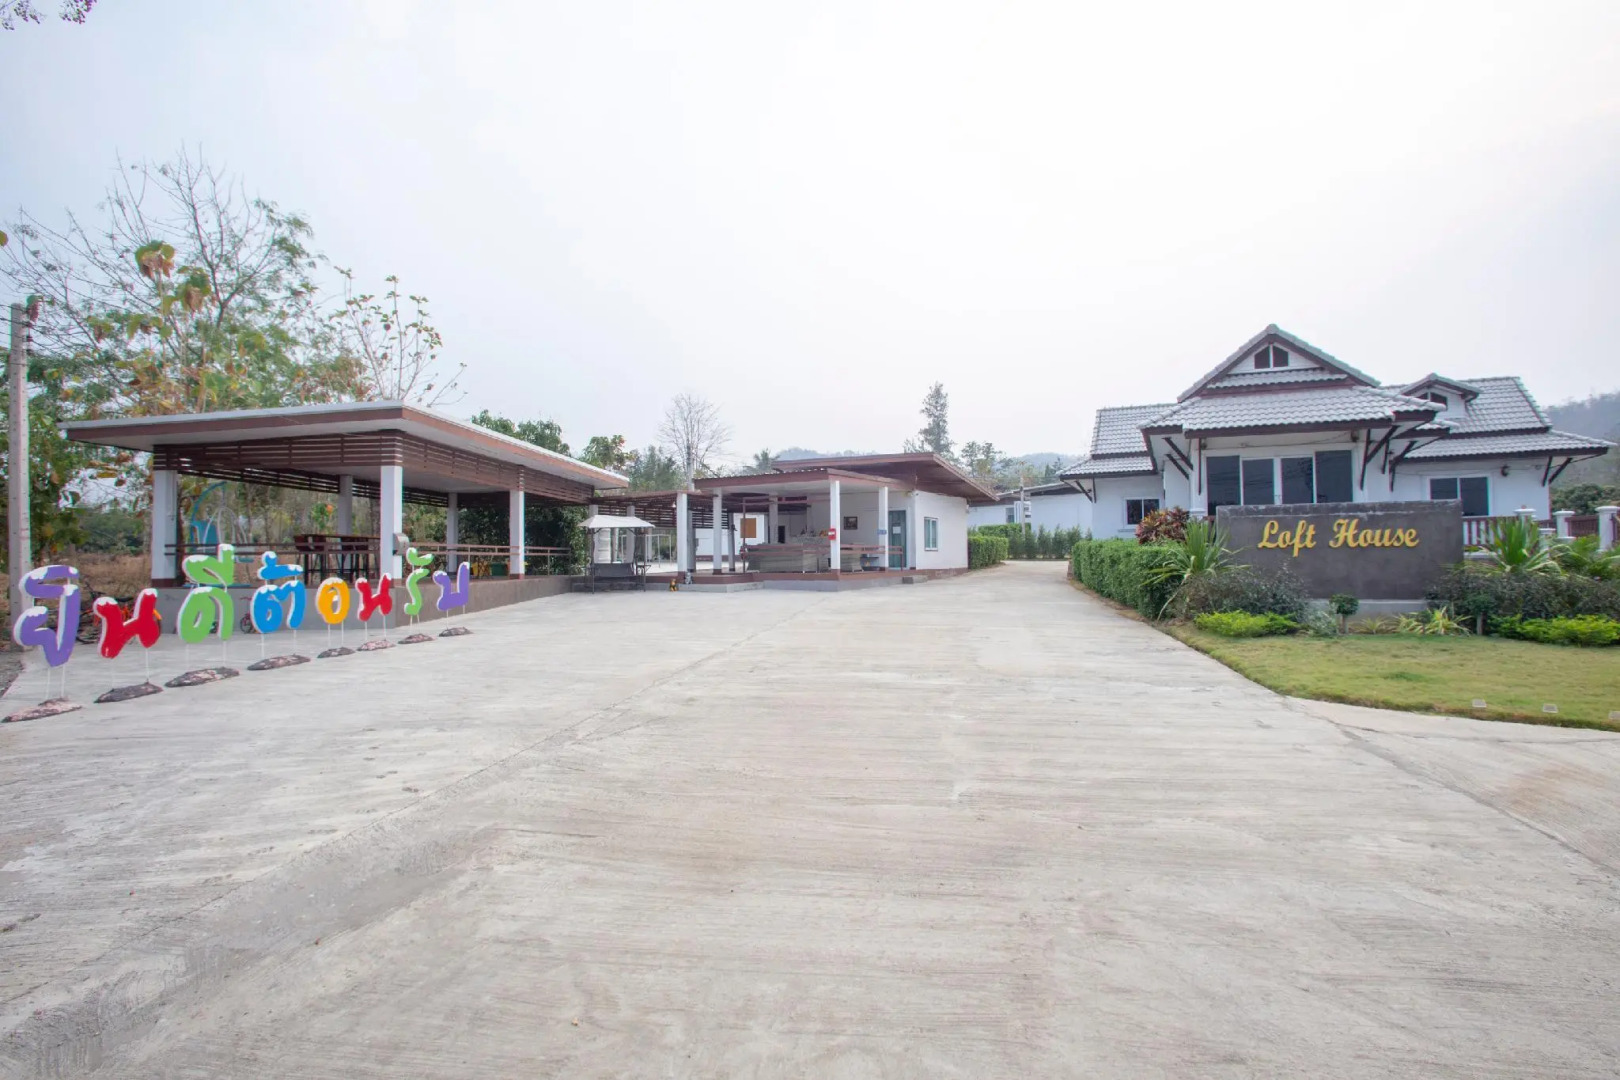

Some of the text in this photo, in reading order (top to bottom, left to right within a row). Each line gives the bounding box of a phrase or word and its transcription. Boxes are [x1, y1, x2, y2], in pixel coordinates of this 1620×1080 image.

[1257, 518, 1420, 558] Loft House
[13, 543, 470, 667] ยินดีต้อนรับ
